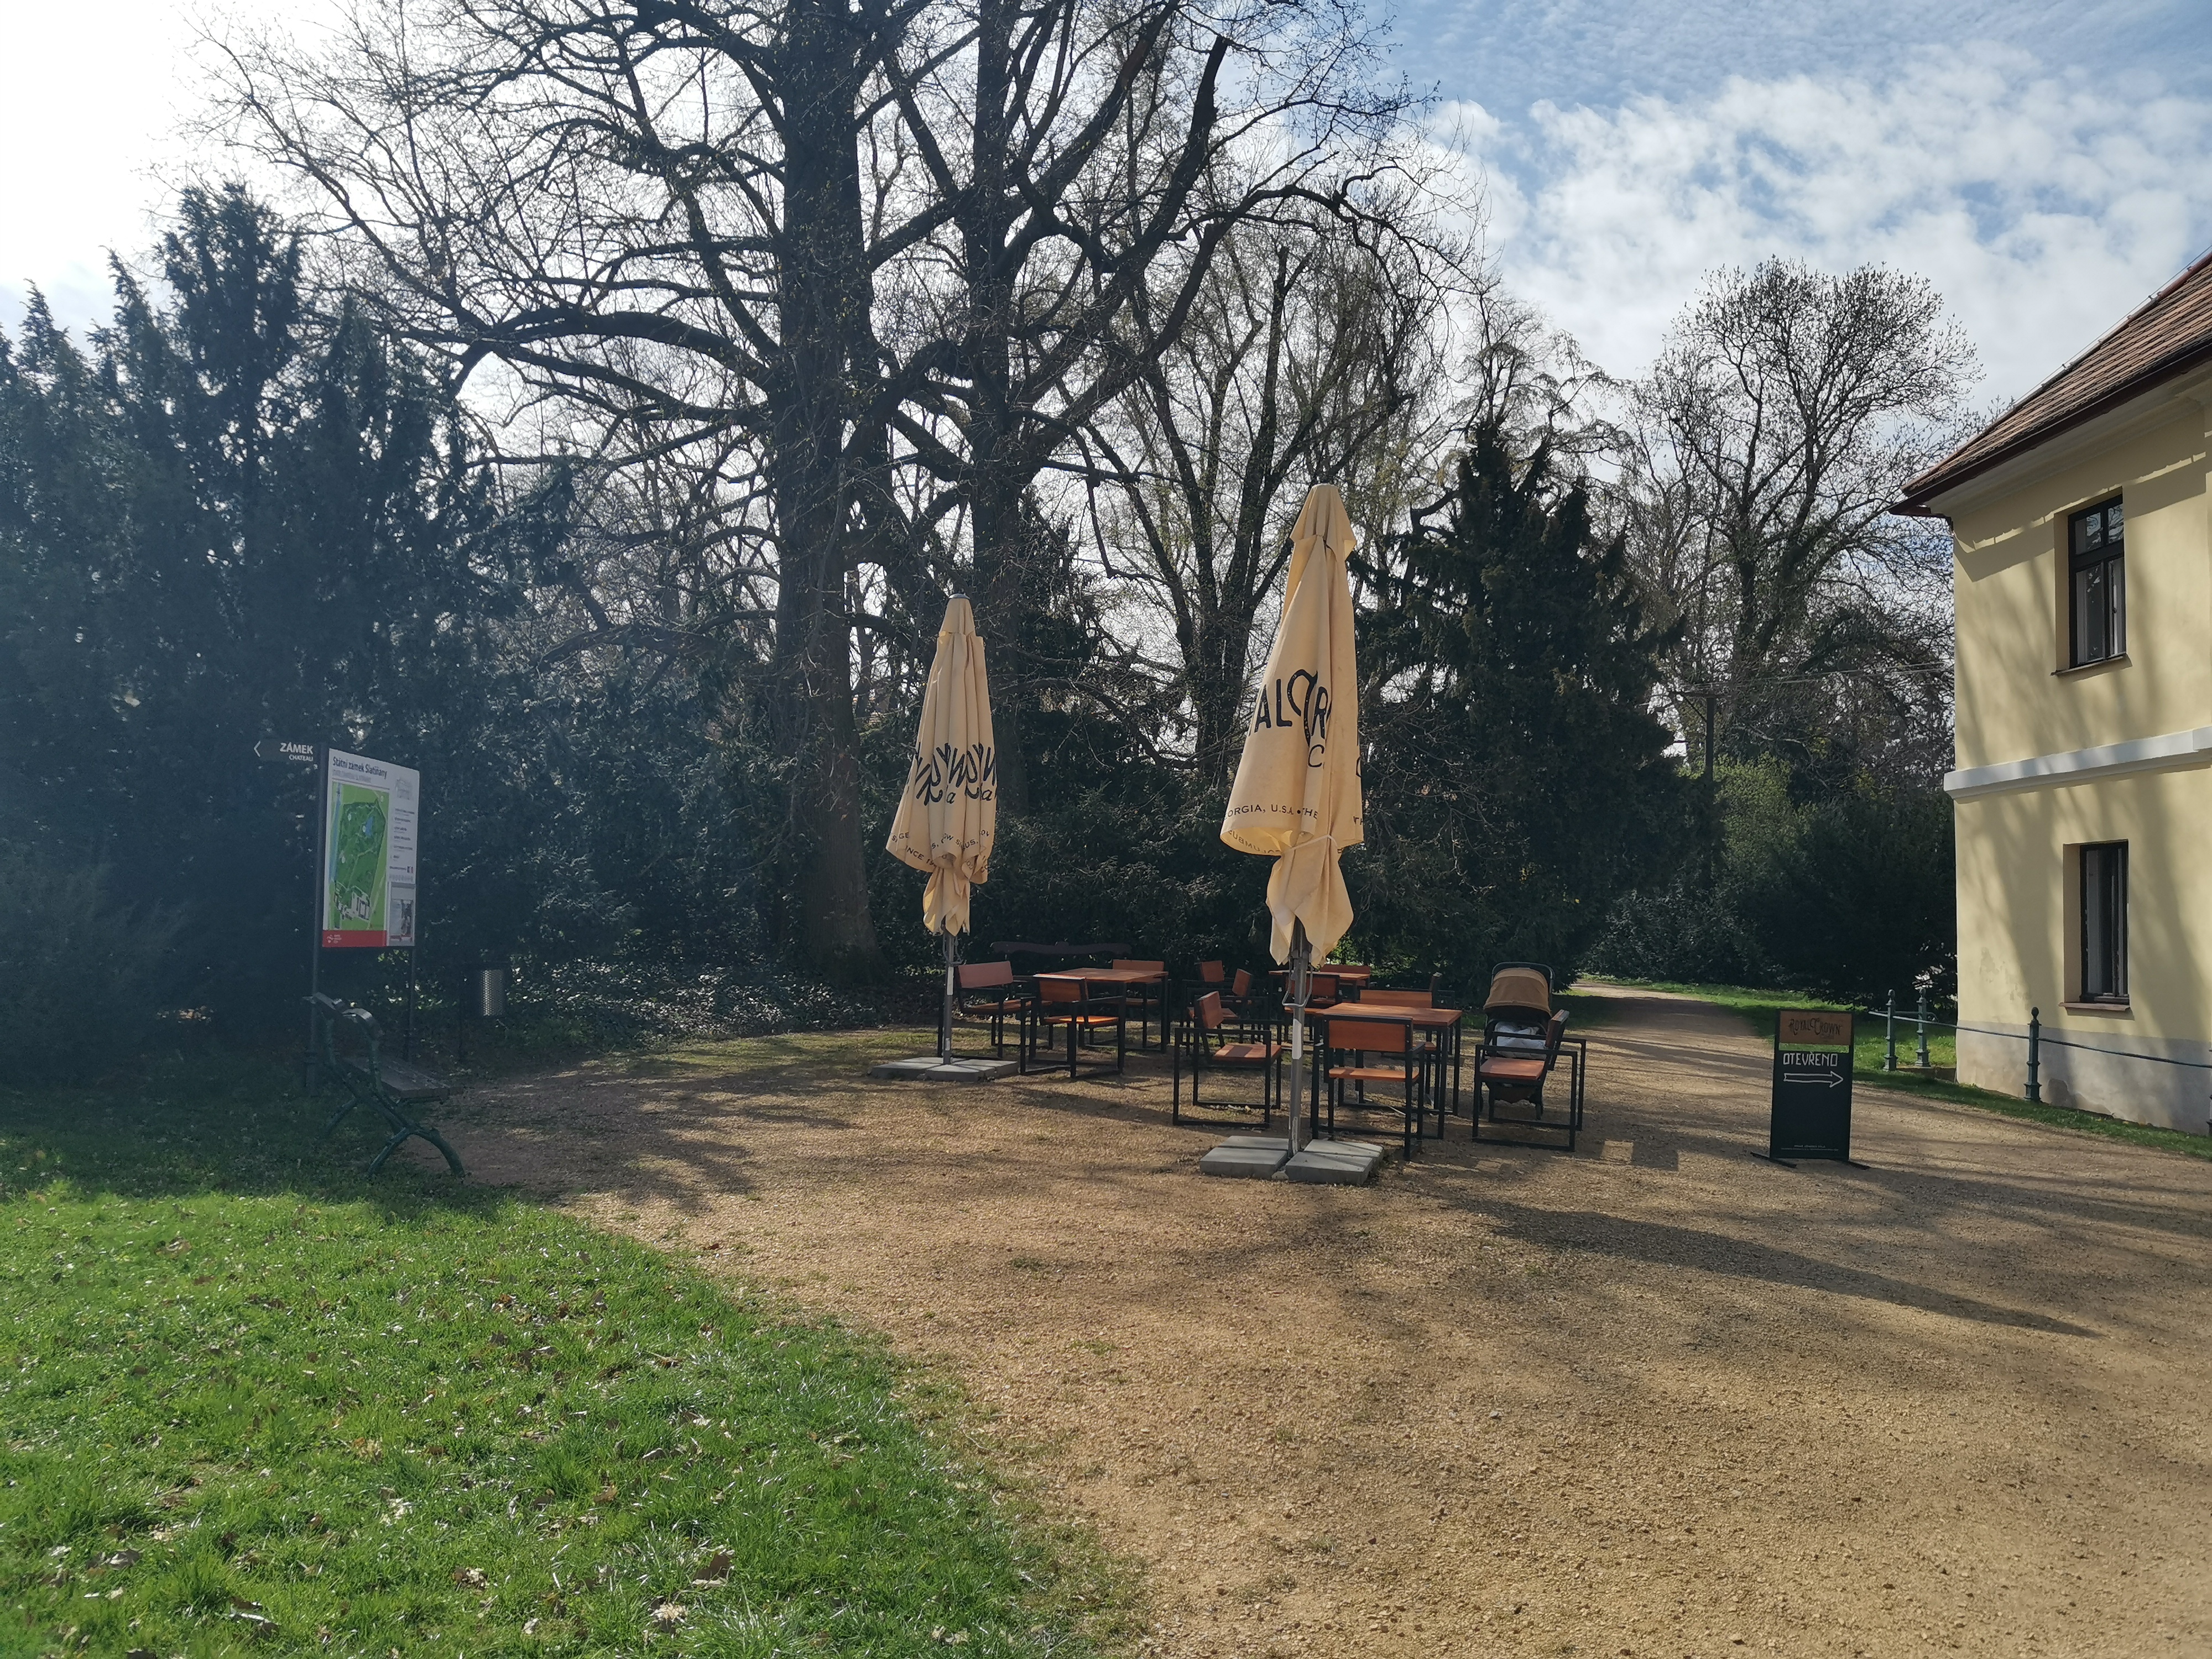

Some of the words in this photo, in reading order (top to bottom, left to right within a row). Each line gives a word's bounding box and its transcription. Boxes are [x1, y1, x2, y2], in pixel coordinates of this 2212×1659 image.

[279, 741, 314, 755] ZÁMEK
[1224, 804, 1266, 820] ORGIA,
[1788, 1018, 1811, 1036] ROYAL
[1809, 1017, 1841, 1036] CROWN
[1782, 1052, 1838, 1067] OTEVŘENO
